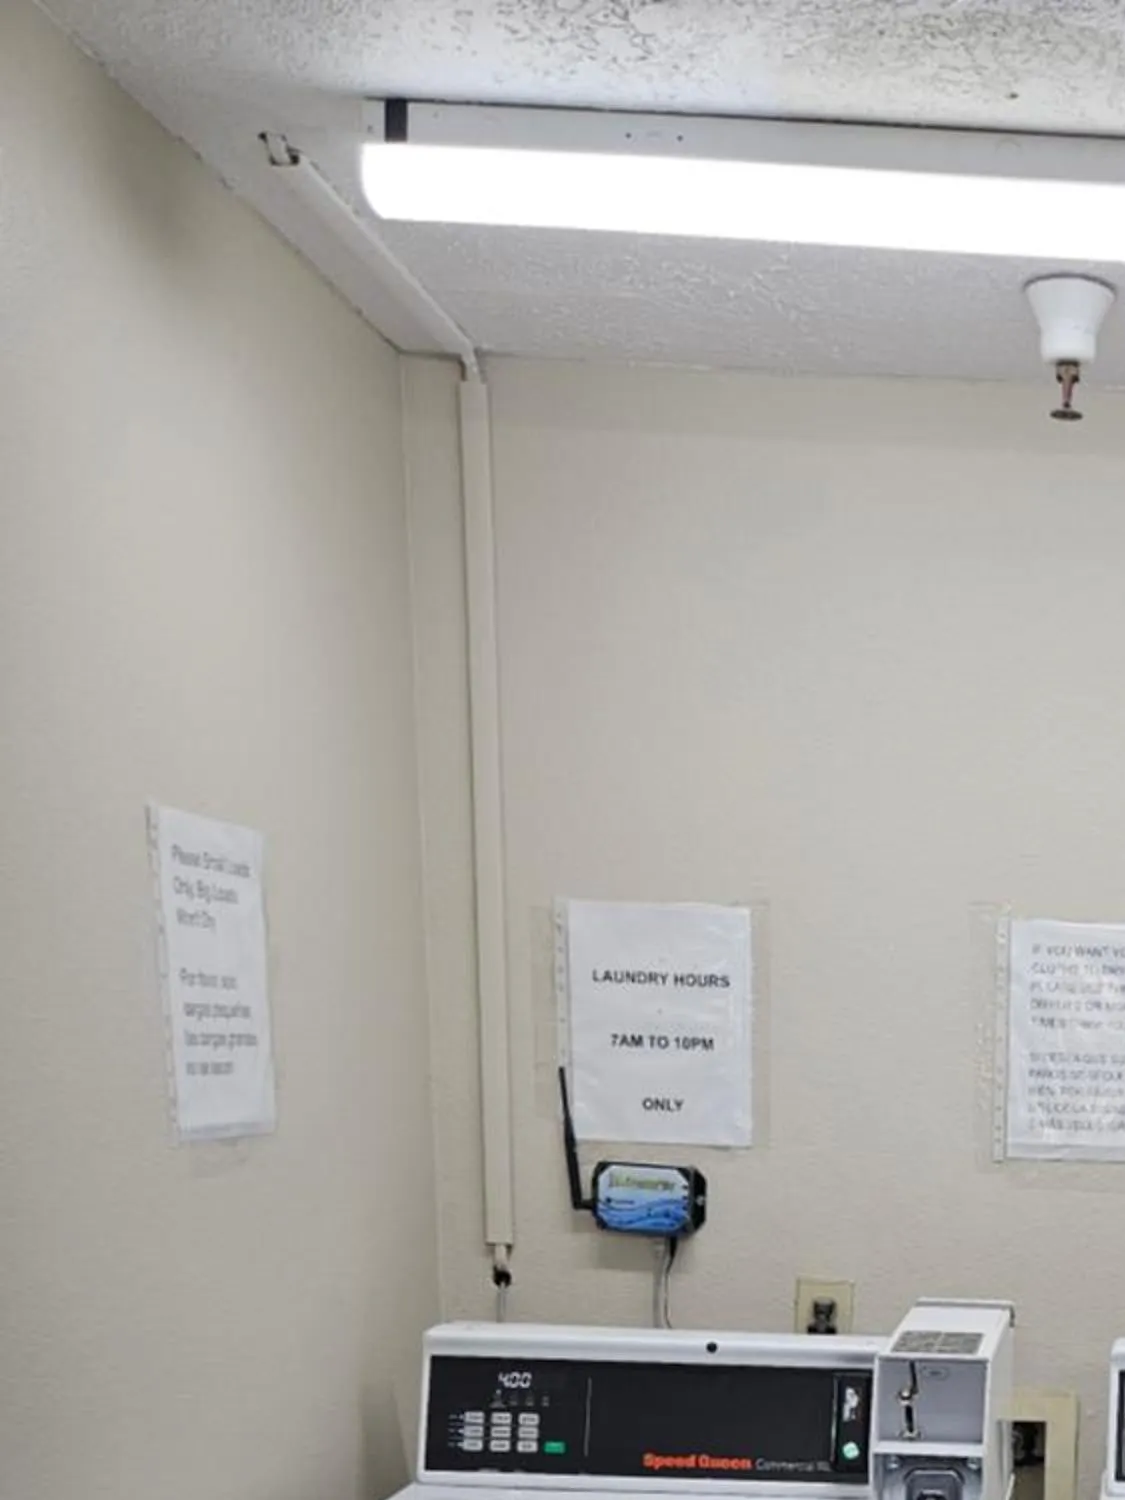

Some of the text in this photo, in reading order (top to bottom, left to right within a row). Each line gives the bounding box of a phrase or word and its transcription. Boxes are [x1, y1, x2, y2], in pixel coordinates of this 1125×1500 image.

[1075, 945, 1109, 958] WANT
[592, 969, 731, 988] LAUNDRY HOURS
[610, 1033, 715, 1051] 7AM TO 10PM
[642, 1097, 684, 1113] ONLY
[498, 1371, 533, 1389] 400
[643, 1453, 697, 1471] Speed
[698, 1454, 753, 1472] Queen
